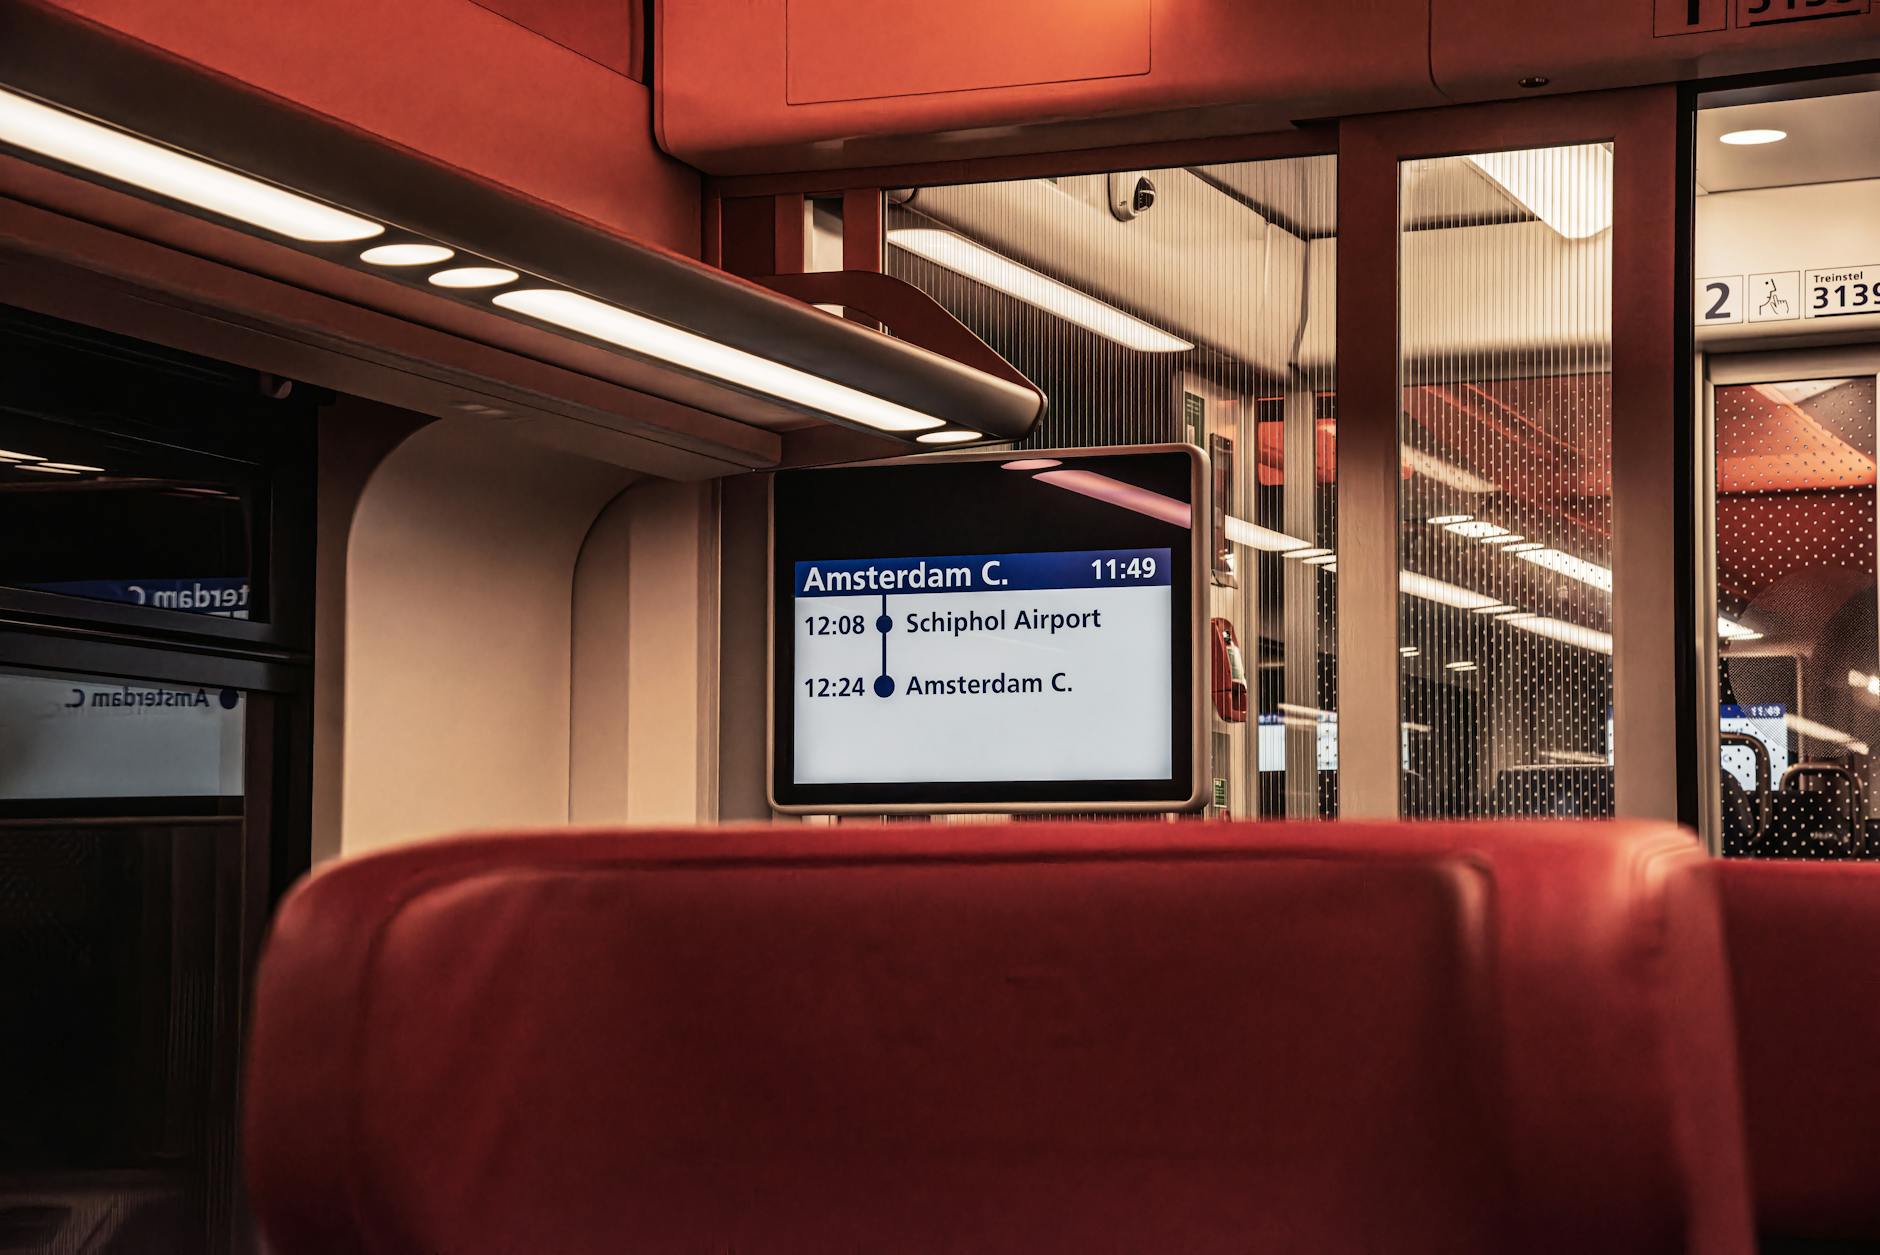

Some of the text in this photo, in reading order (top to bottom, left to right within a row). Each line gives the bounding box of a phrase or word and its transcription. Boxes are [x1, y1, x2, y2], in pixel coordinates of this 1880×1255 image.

[1814, 271, 1863, 283] Treinstel
[1705, 282, 1731, 320] 2
[803, 560, 1009, 592] Amsterdam C.
[1091, 557, 1156, 580] 11:49
[804, 615, 866, 636] 12:08
[906, 608, 1102, 637] Schiphol Airport
[804, 677, 866, 698] 12:24
[905, 672, 1074, 696] Amsterdam C.
